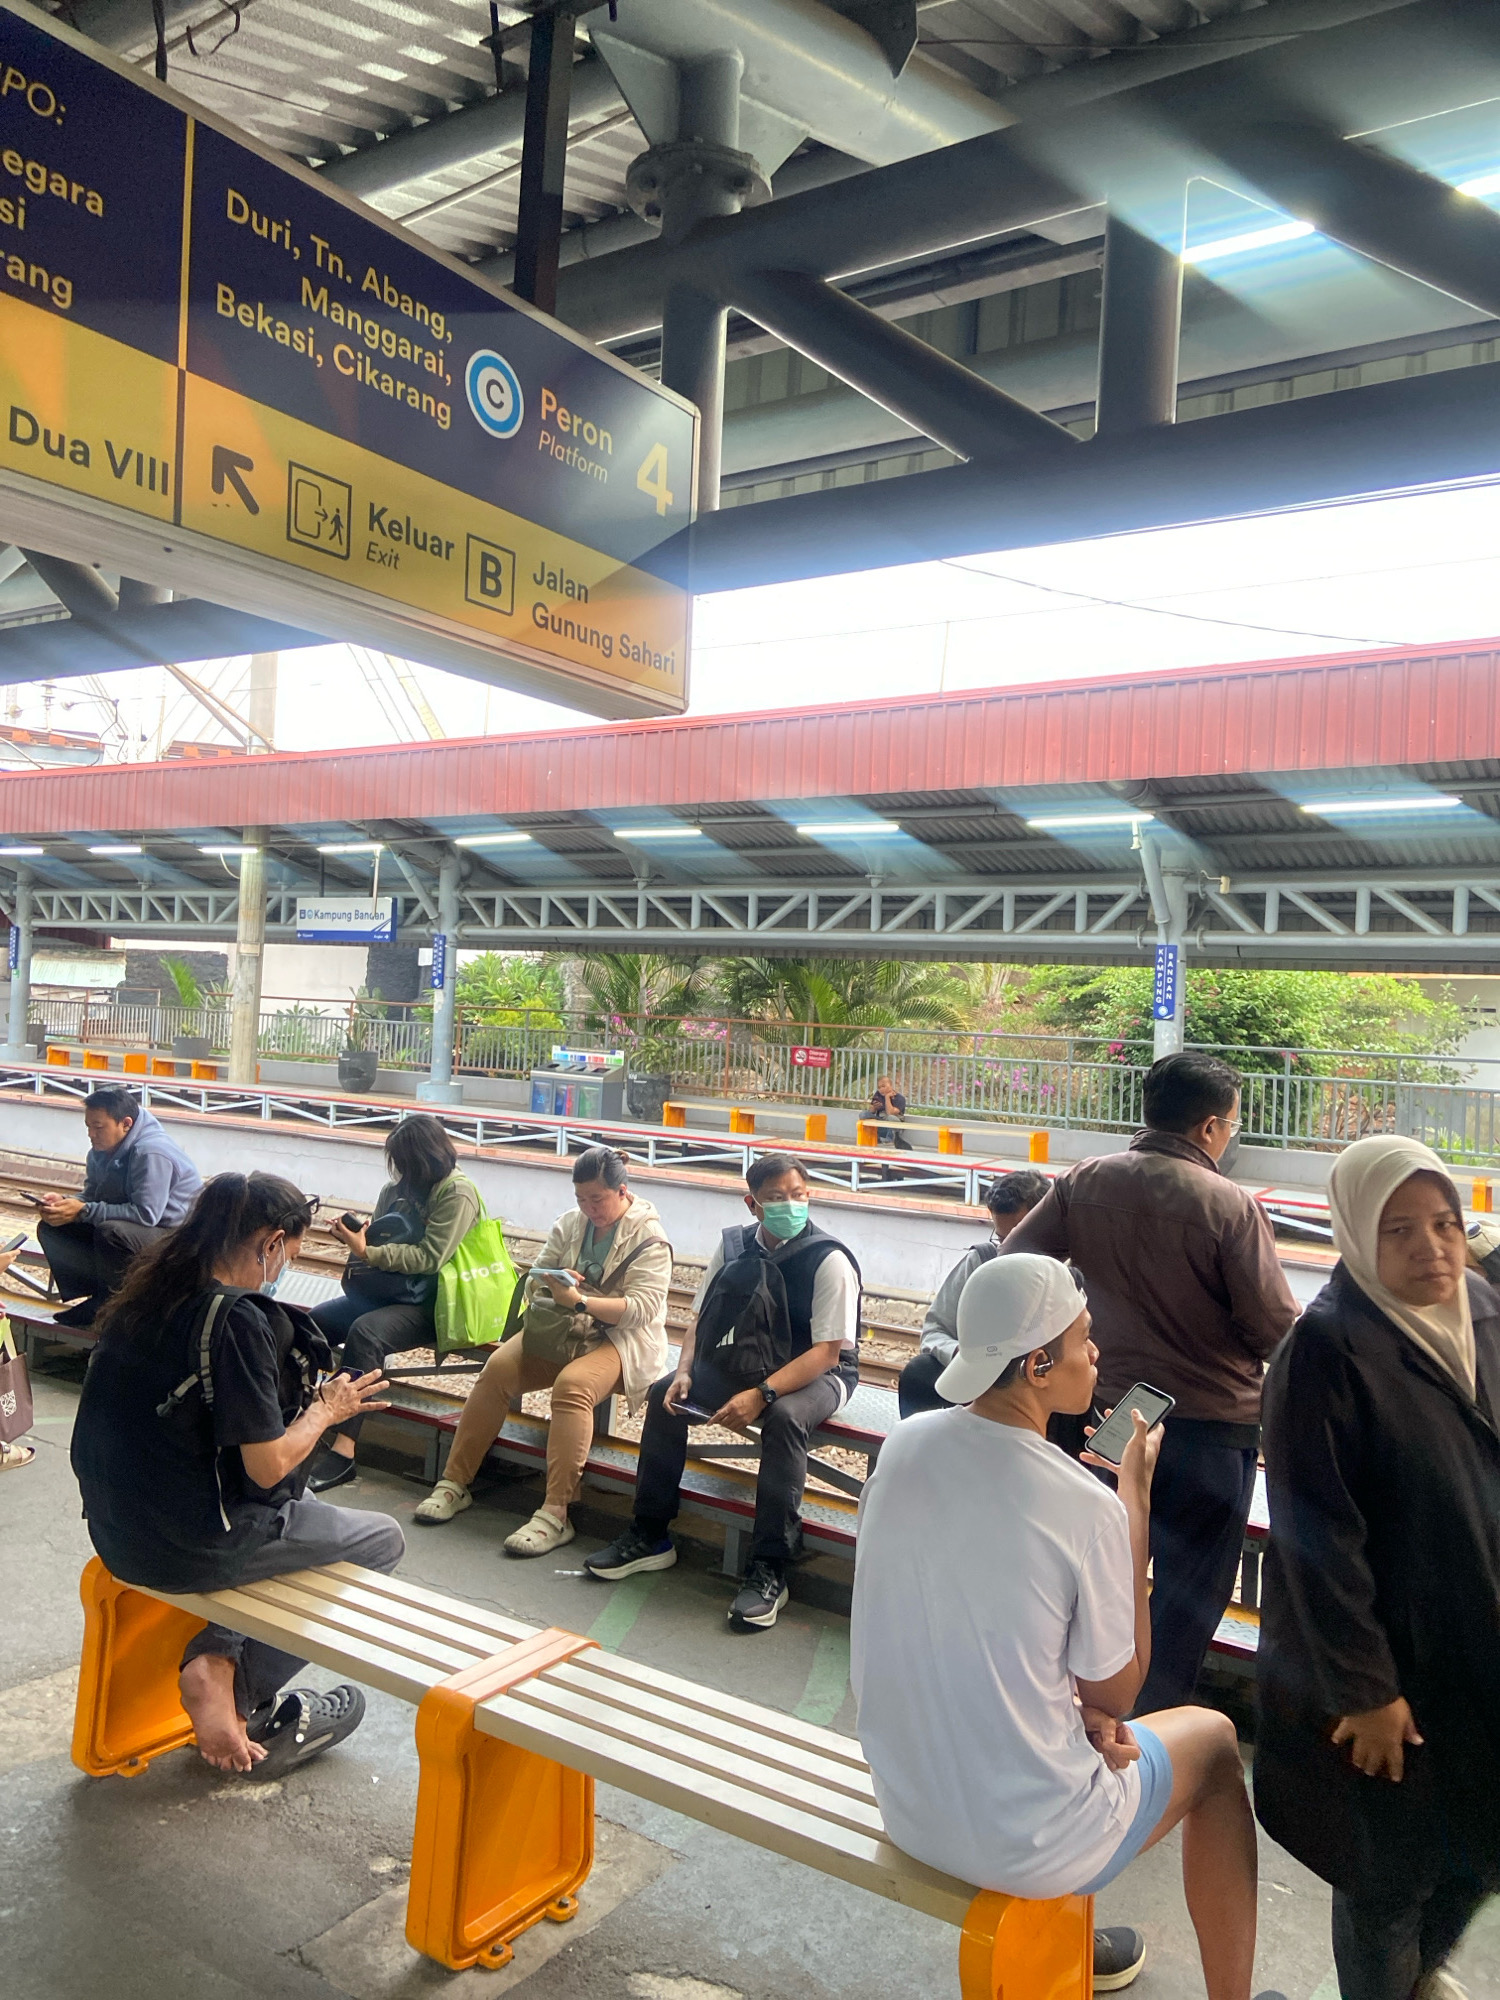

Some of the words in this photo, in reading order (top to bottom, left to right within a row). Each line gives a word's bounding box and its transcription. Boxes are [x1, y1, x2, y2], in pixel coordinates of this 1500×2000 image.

[0, 62, 66, 126] PO:
[227, 188, 301, 260] Duri,
[310, 234, 352, 284] Tn.
[361, 266, 453, 343] Abang,
[216, 282, 323, 368] Bekasi,
[333, 343, 451, 430] Cikarang
[302, 276, 452, 386] Manggarai,
[485, 378, 505, 410] C
[541, 387, 613, 455] Peron
[9, 405, 91, 468] Dua
[104, 439, 169, 496] VIII
[538, 430, 609, 484] Platform
[636, 441, 674, 517] 4
[366, 541, 401, 570] Exit
[368, 502, 455, 560] Keluar
[479, 550, 503, 598] B
[532, 561, 589, 604] Jalan
[532, 602, 614, 659] Gunung
[619, 633, 676, 675] Sahari
[314, 909, 352, 922] Kampung
[1155, 948, 1164, 1004] KAMPUNG
[1165, 952, 1174, 1000] BANDAN
